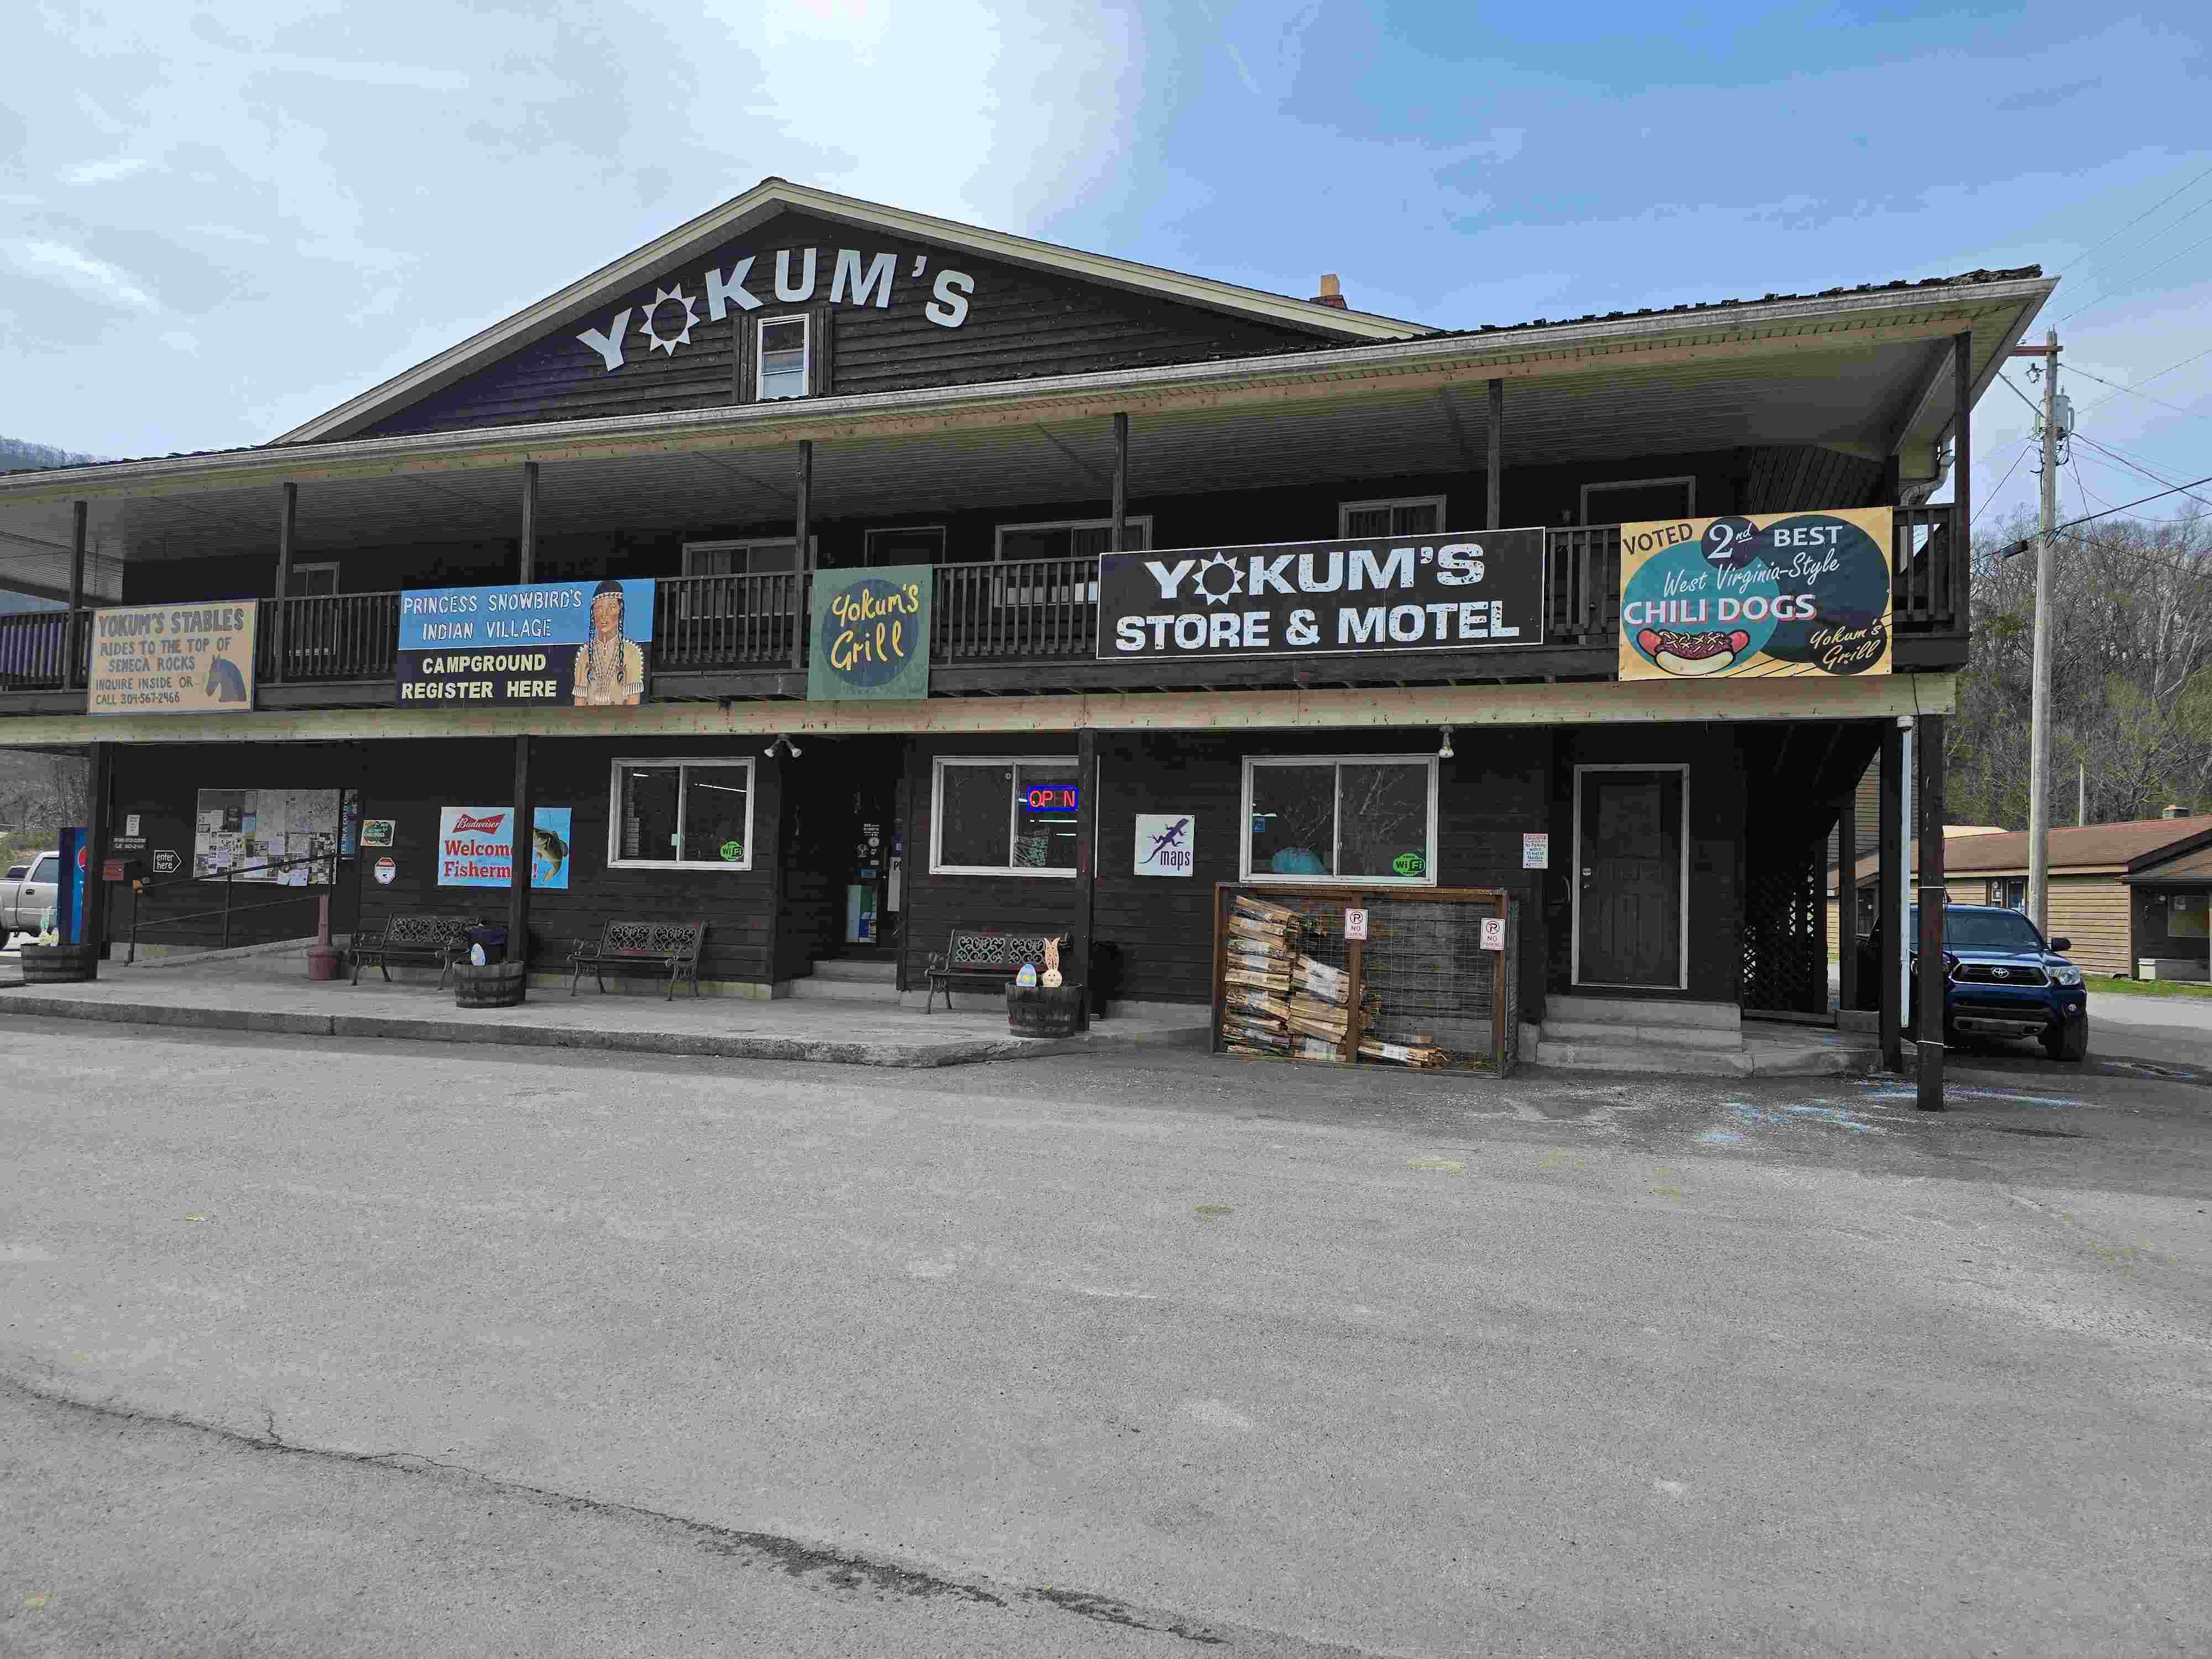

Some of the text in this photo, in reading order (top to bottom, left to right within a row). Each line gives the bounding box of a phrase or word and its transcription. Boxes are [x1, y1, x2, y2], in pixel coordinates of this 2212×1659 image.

[576, 247, 974, 372] YOKUM'S
[1623, 522, 1844, 559] VOTED 2nd BEST
[1144, 543, 1484, 606] YOKUM'S
[1663, 548, 1840, 598] West Virginia-Style
[403, 588, 583, 615] PRINCESS SNOWBIRD'S
[832, 584, 919, 627] Yokum's
[1624, 593, 1817, 625] CHILI DOGS
[98, 608, 244, 637] YOKUM'S STABLES
[422, 618, 552, 640] INDIAN VILLAGE
[1115, 601, 1520, 651] STORE & MOTEL
[1810, 618, 1882, 649] Yokum's
[100, 637, 232, 656] RIDES TO THE TOP OF
[831, 620, 904, 671] Grill
[1823, 640, 1880, 670] Grill
[108, 655, 195, 673] SENECA ROCKS
[422, 654, 546, 674] CAMPGROUND
[96, 677, 133, 691] INQUIRE
[138, 676, 173, 690] INSIDE
[401, 680, 557, 698] REGISTER HERE
[96, 694, 117, 705] CALL
[455, 817, 500, 829] Budweiser
[156, 852, 174, 862] enter
[444, 839, 514, 857] Welcom
[156, 861, 173, 870] here
[1160, 851, 1190, 870] maps
